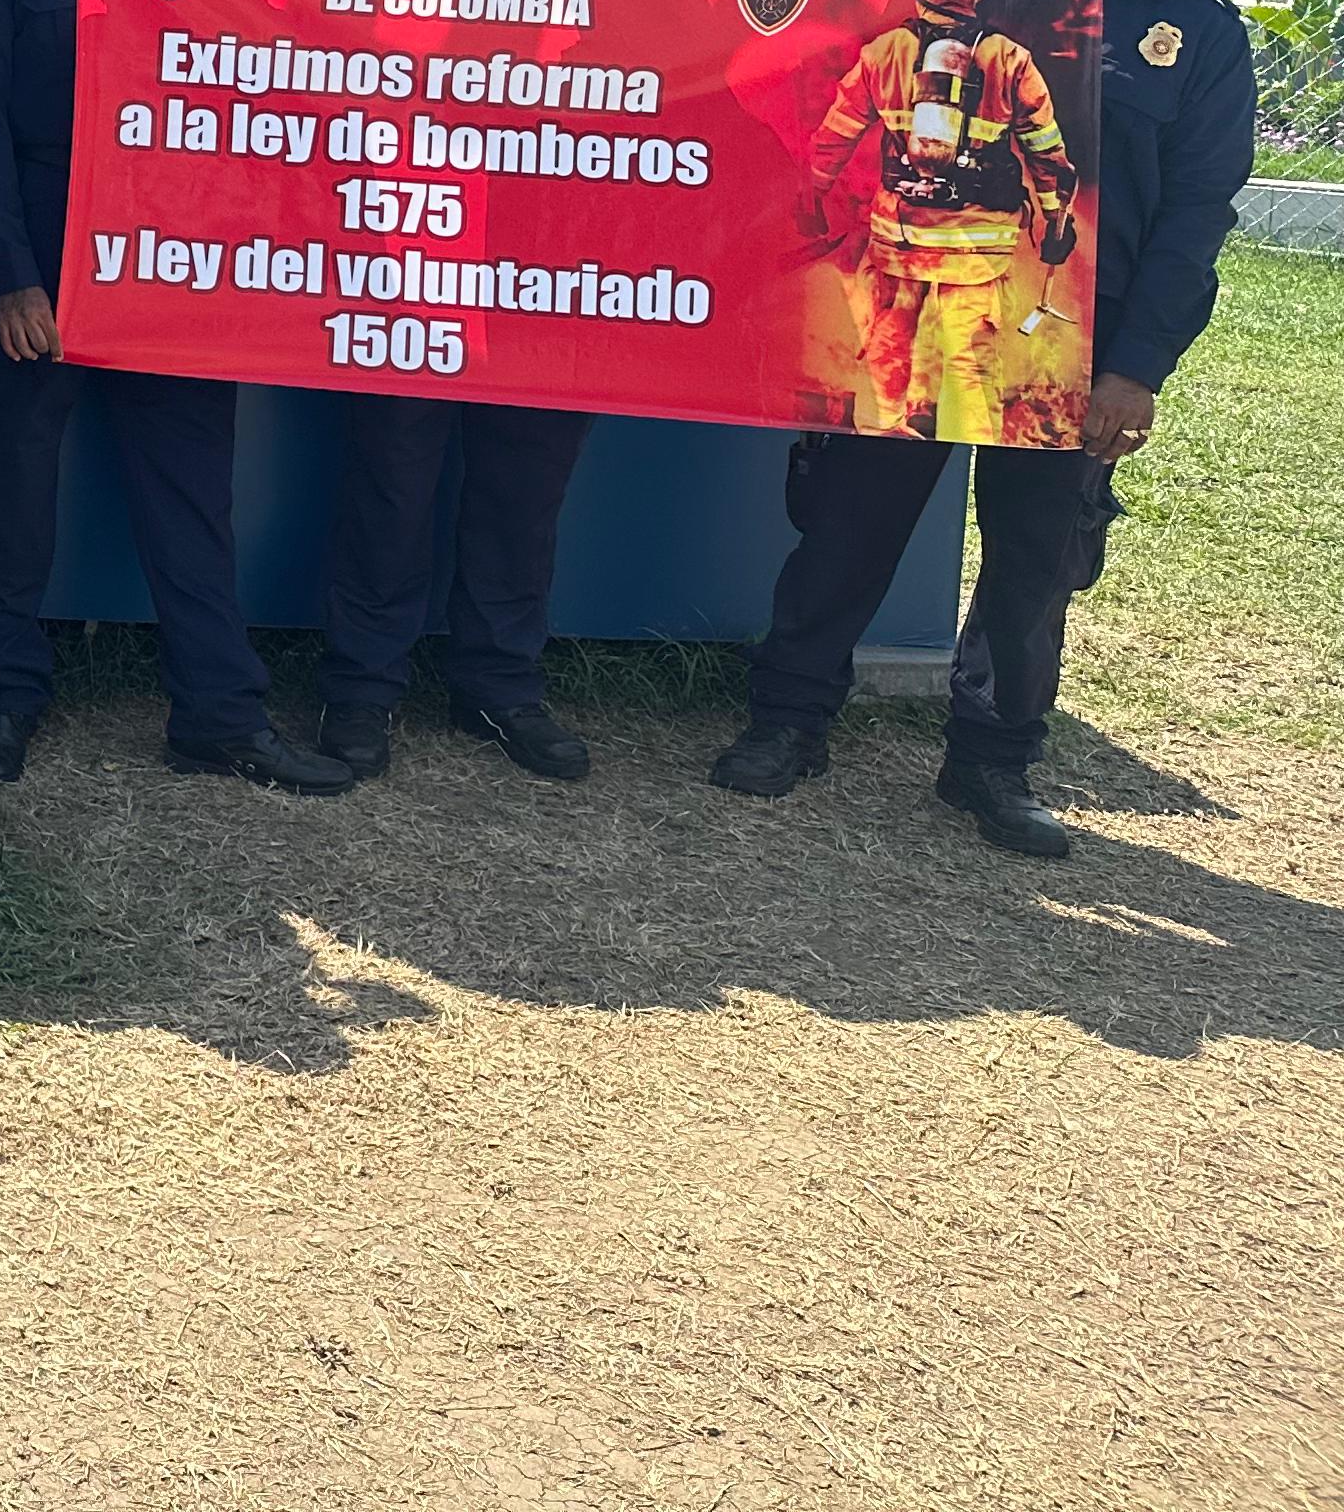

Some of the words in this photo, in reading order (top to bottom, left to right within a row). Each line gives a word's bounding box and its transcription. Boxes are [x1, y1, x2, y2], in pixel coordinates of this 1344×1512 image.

[161, 31, 413, 98] Exigimos
[426, 53, 660, 113] reforma
[119, 104, 153, 147] a
[165, 98, 218, 152] la
[231, 103, 317, 163] ley
[328, 110, 399, 165] de
[412, 115, 708, 185] bomberos
[336, 178, 463, 237] 1575
[94, 234, 127, 282] y
[137, 229, 223, 290] ley
[234, 238, 324, 294] del
[336, 250, 710, 324] voluntariado
[324, 313, 464, 374] 1505
